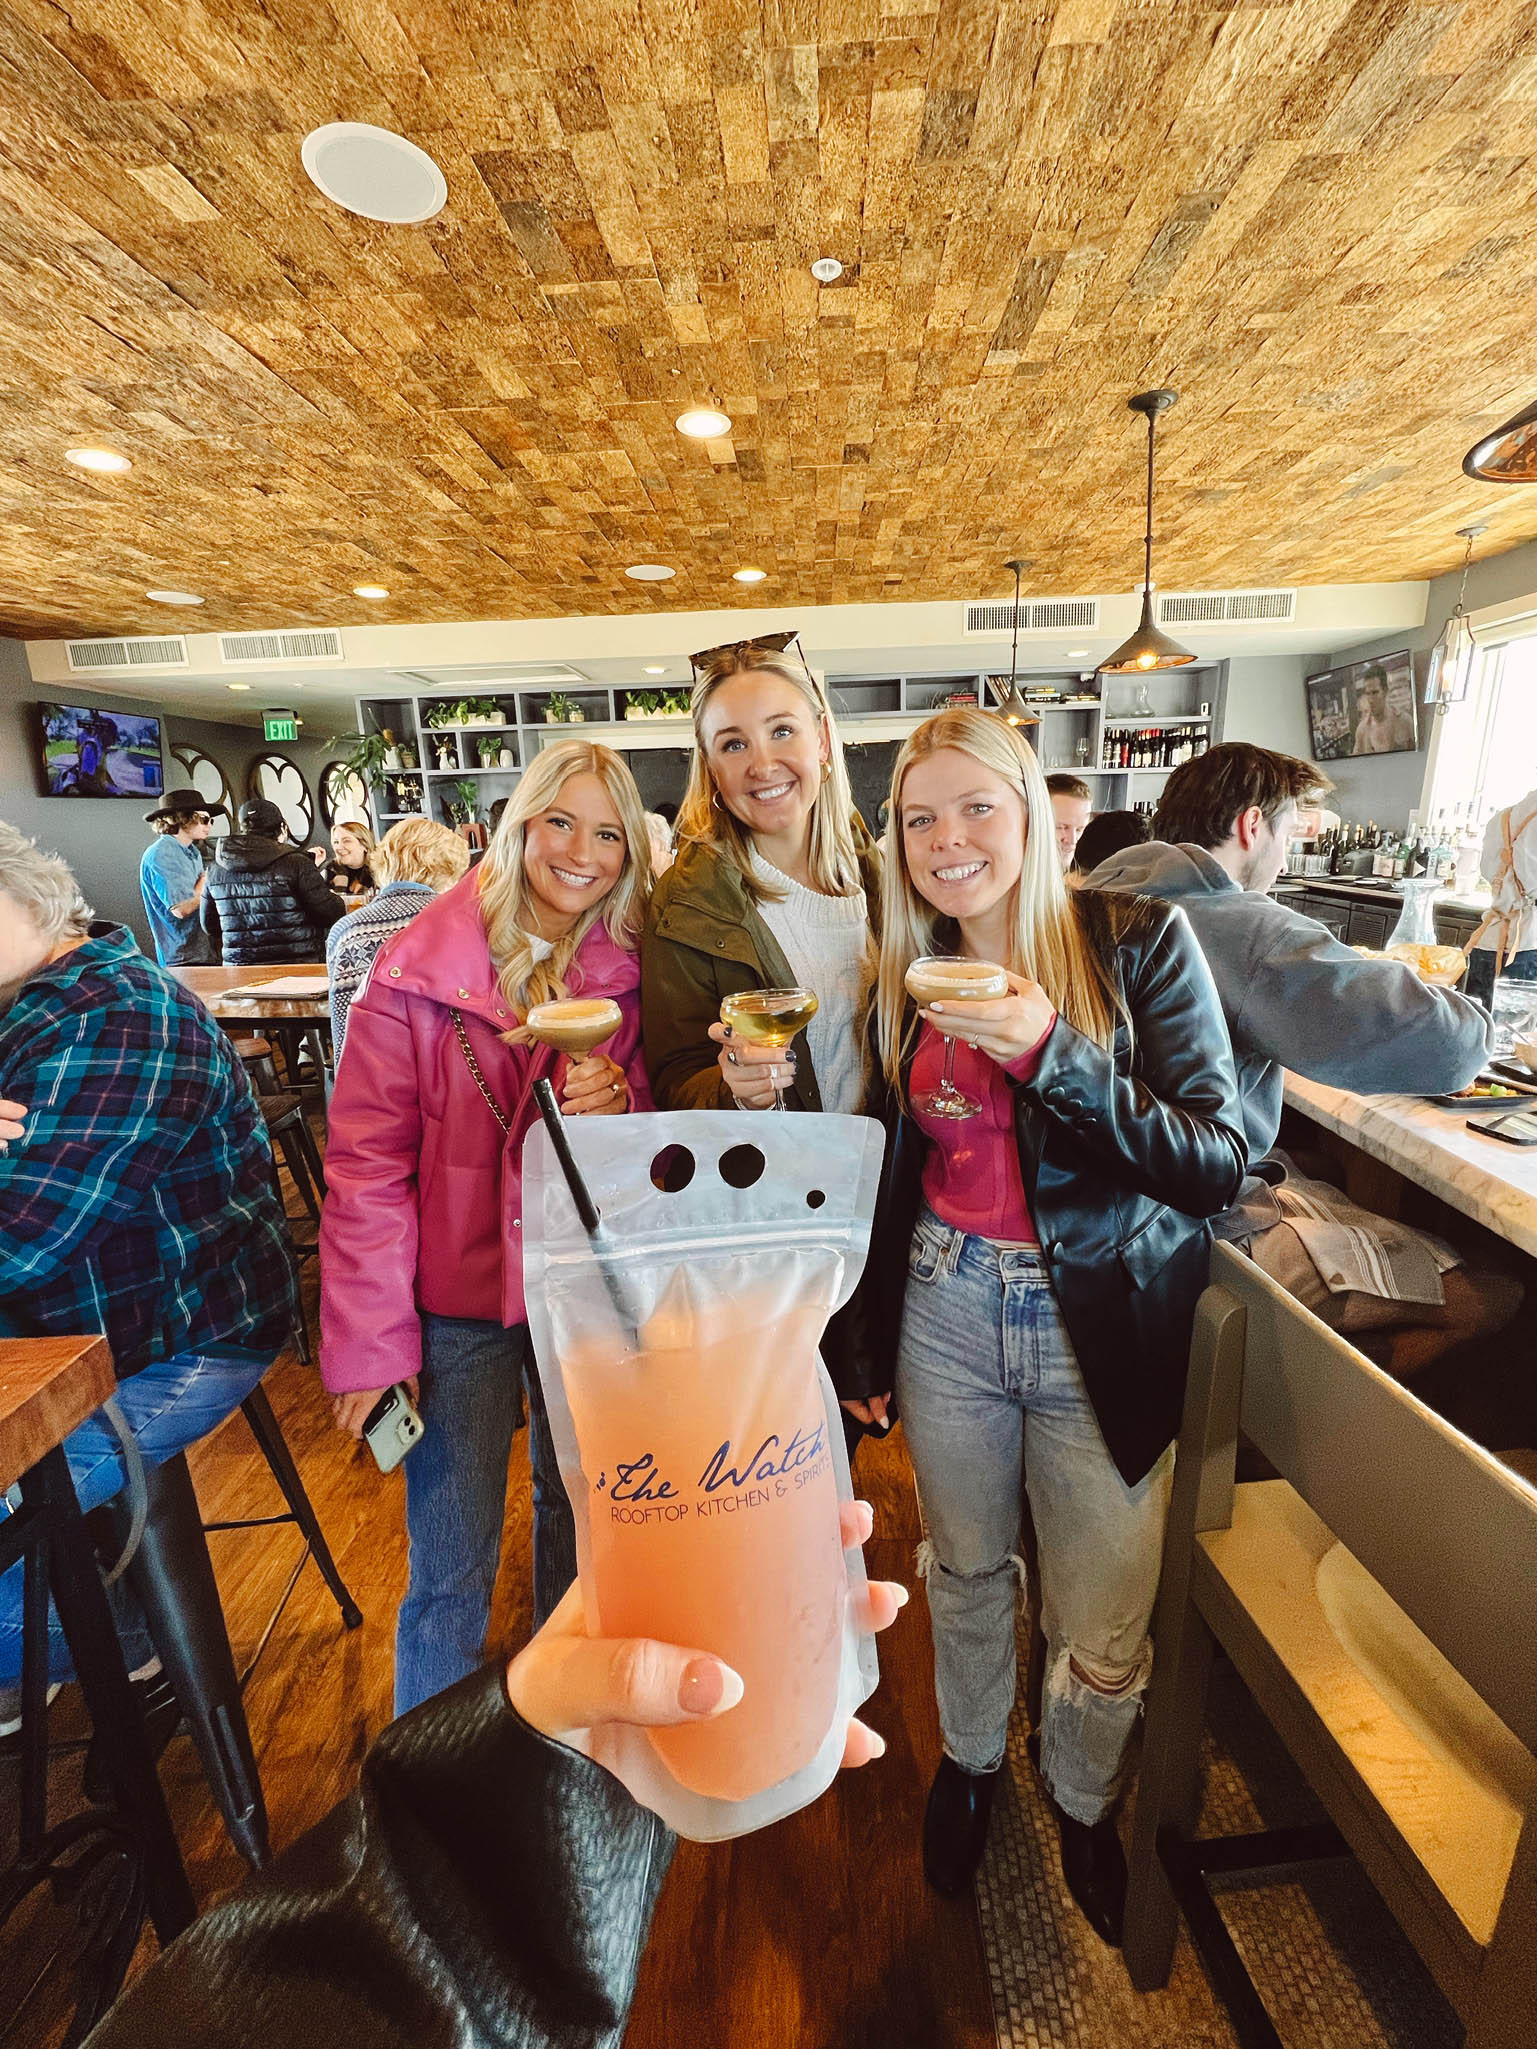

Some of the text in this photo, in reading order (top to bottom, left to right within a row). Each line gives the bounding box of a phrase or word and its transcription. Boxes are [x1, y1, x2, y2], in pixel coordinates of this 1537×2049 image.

[270, 720, 293, 740] EXIT
[611, 1420, 824, 1502] The Watch
[611, 1504, 689, 1525] ROOFTOP
[697, 1487, 770, 1517] KITCHEN
[775, 1480, 788, 1497] &
